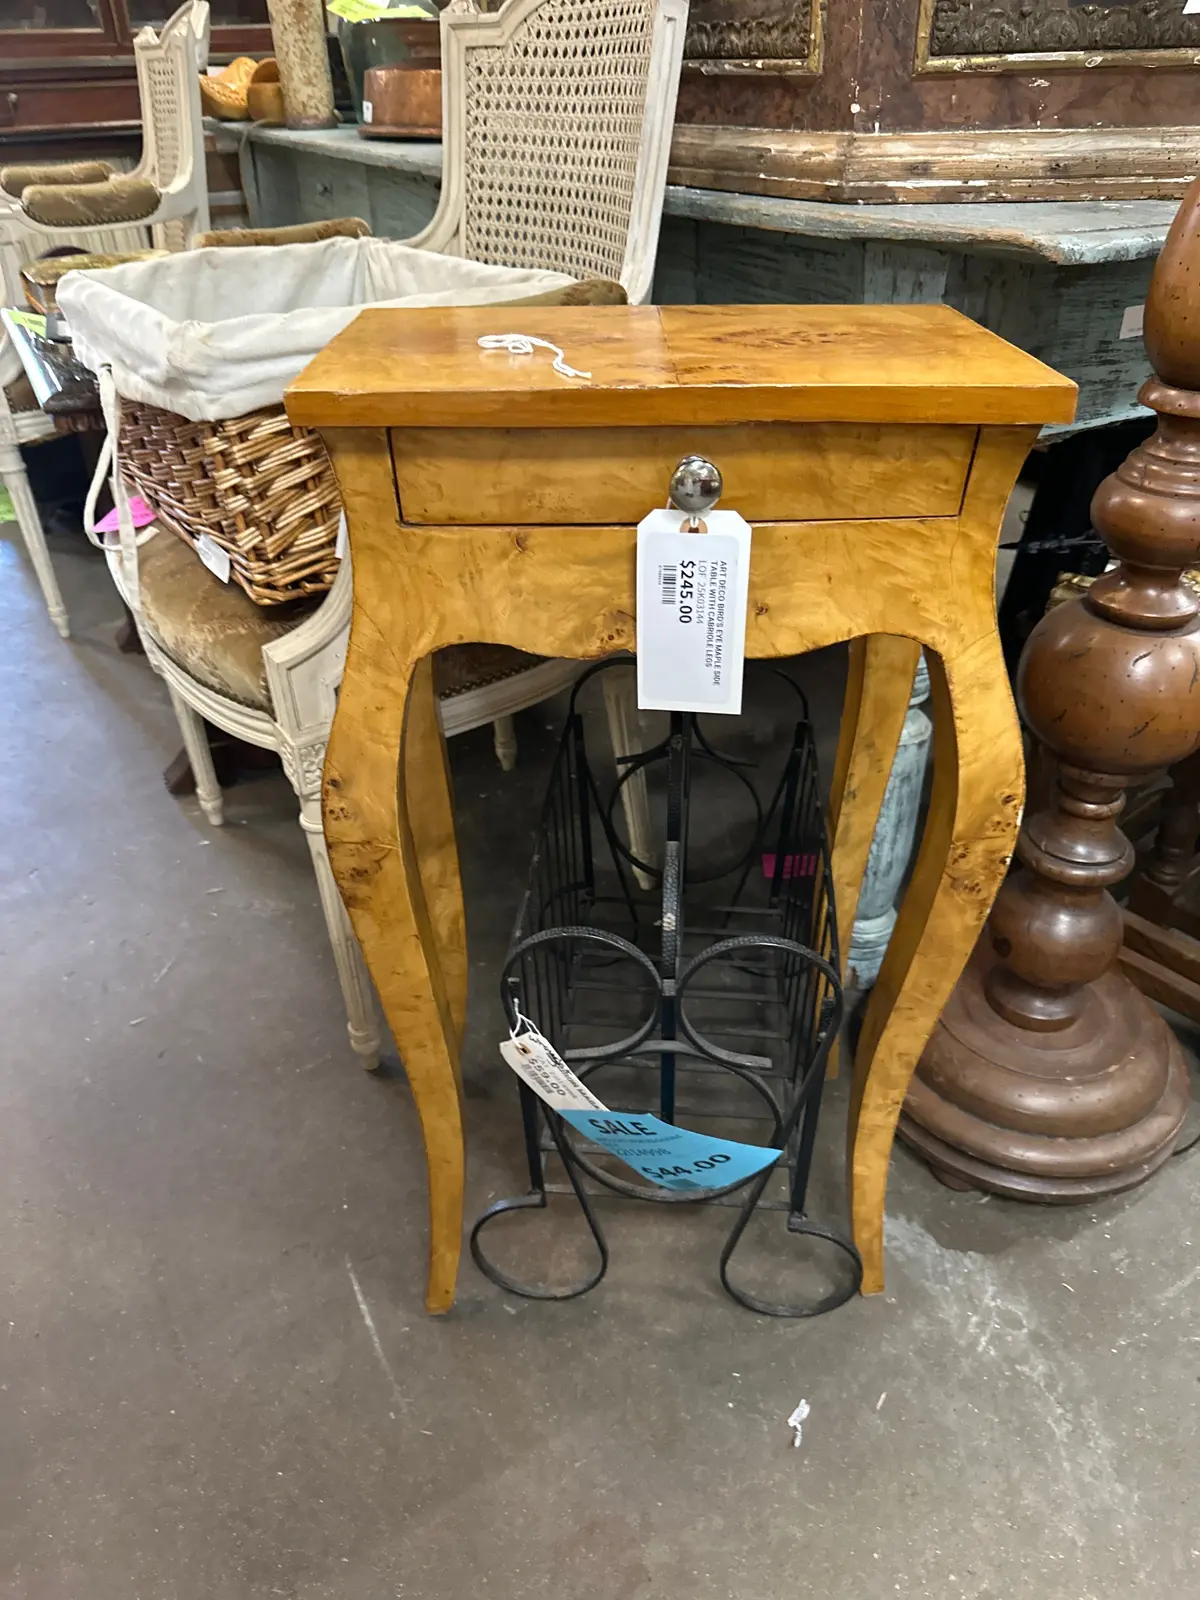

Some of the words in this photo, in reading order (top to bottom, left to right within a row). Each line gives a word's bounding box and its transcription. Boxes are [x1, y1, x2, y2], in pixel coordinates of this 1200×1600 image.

[697, 560, 707, 578] LOF
[709, 560, 718, 587] TABLE
[718, 560, 727, 578] ART
[679, 560, 697, 624] $245.00
[707, 588, 717, 610] WITH
[717, 579, 727, 602] DECO
[715, 603, 725, 628] BIRD'S
[705, 611, 716, 648] CABRIOLE
[715, 629, 724, 643] EYE
[704, 649, 713, 668] LEGS
[713, 644, 723, 669] MAPLE
[712, 670, 721, 687] SIDE
[528, 1058, 566, 1097] $59.00
[588, 1118, 657, 1136] SALE
[642, 1154, 731, 1179] $44.00
